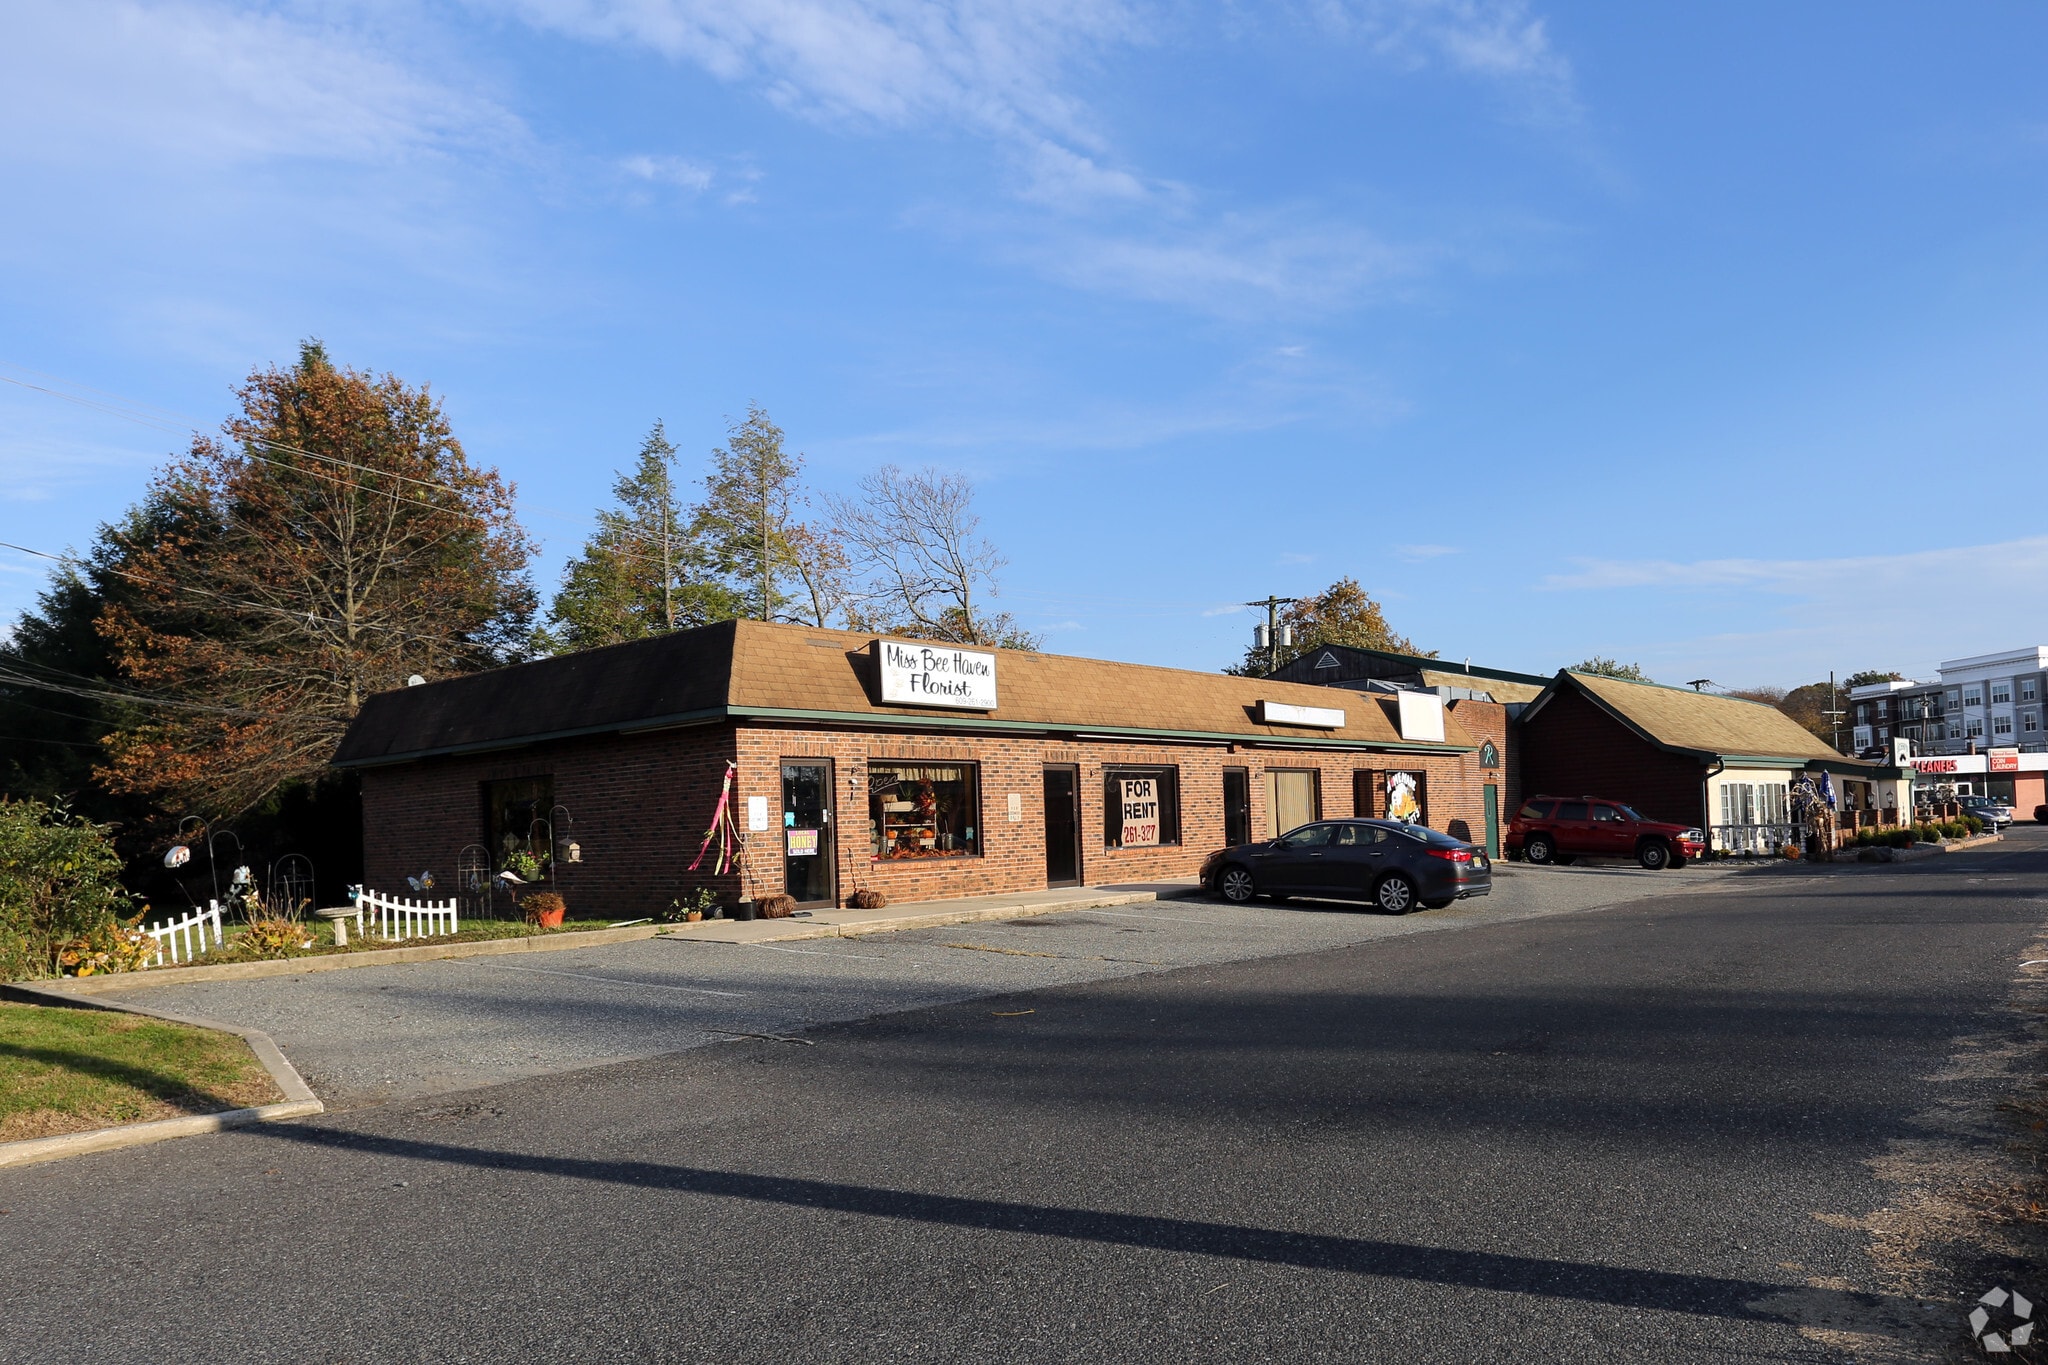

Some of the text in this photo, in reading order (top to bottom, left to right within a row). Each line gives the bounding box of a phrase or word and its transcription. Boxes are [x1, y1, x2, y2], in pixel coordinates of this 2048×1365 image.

[887, 644, 991, 677] Miss Bee Haven
[910, 672, 972, 697] Florist
[1125, 780, 1151, 798] FOR
[1123, 801, 1157, 820] RENT
[790, 835, 816, 849] HONEY
[1123, 824, 1156, 844] 261-327
